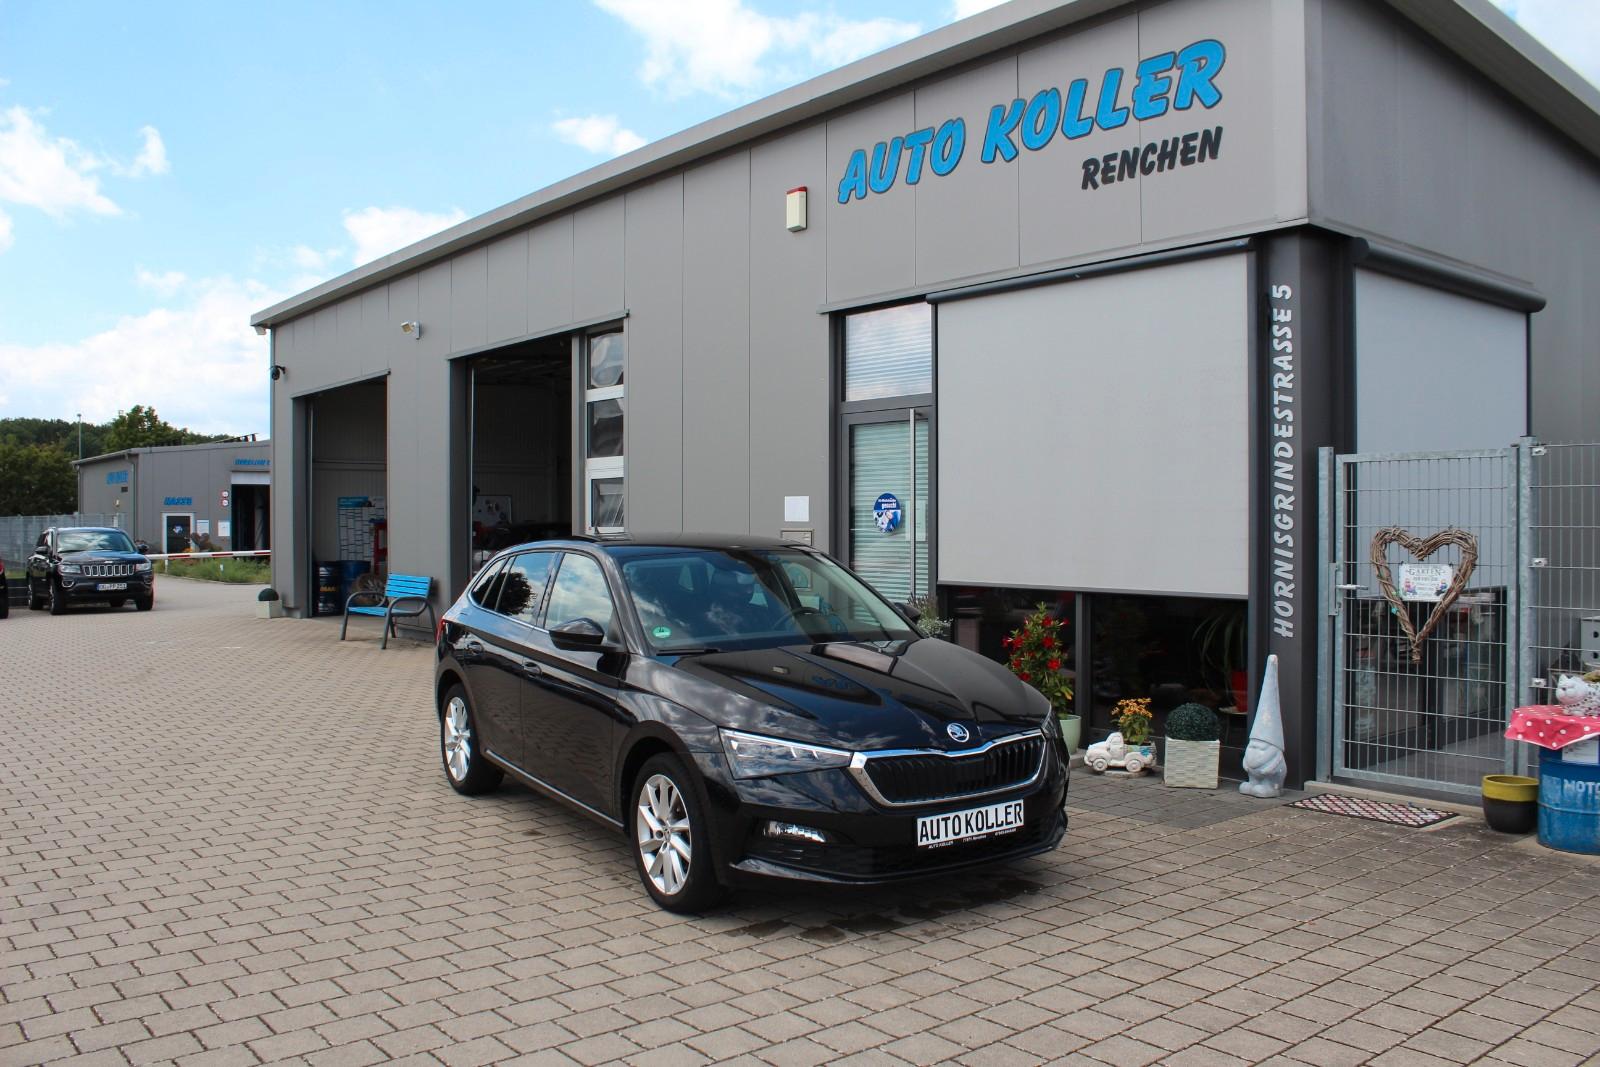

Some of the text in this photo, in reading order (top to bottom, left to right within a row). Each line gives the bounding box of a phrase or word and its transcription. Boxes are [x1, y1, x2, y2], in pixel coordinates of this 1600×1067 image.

[838, 39, 1226, 204] AUTO KOLLER
[1081, 126, 1223, 190] RENCHEN
[1272, 285, 1295, 637] HORNISGRINDESTRASSE 5
[920, 803, 1022, 842] AUTO KOLLER
